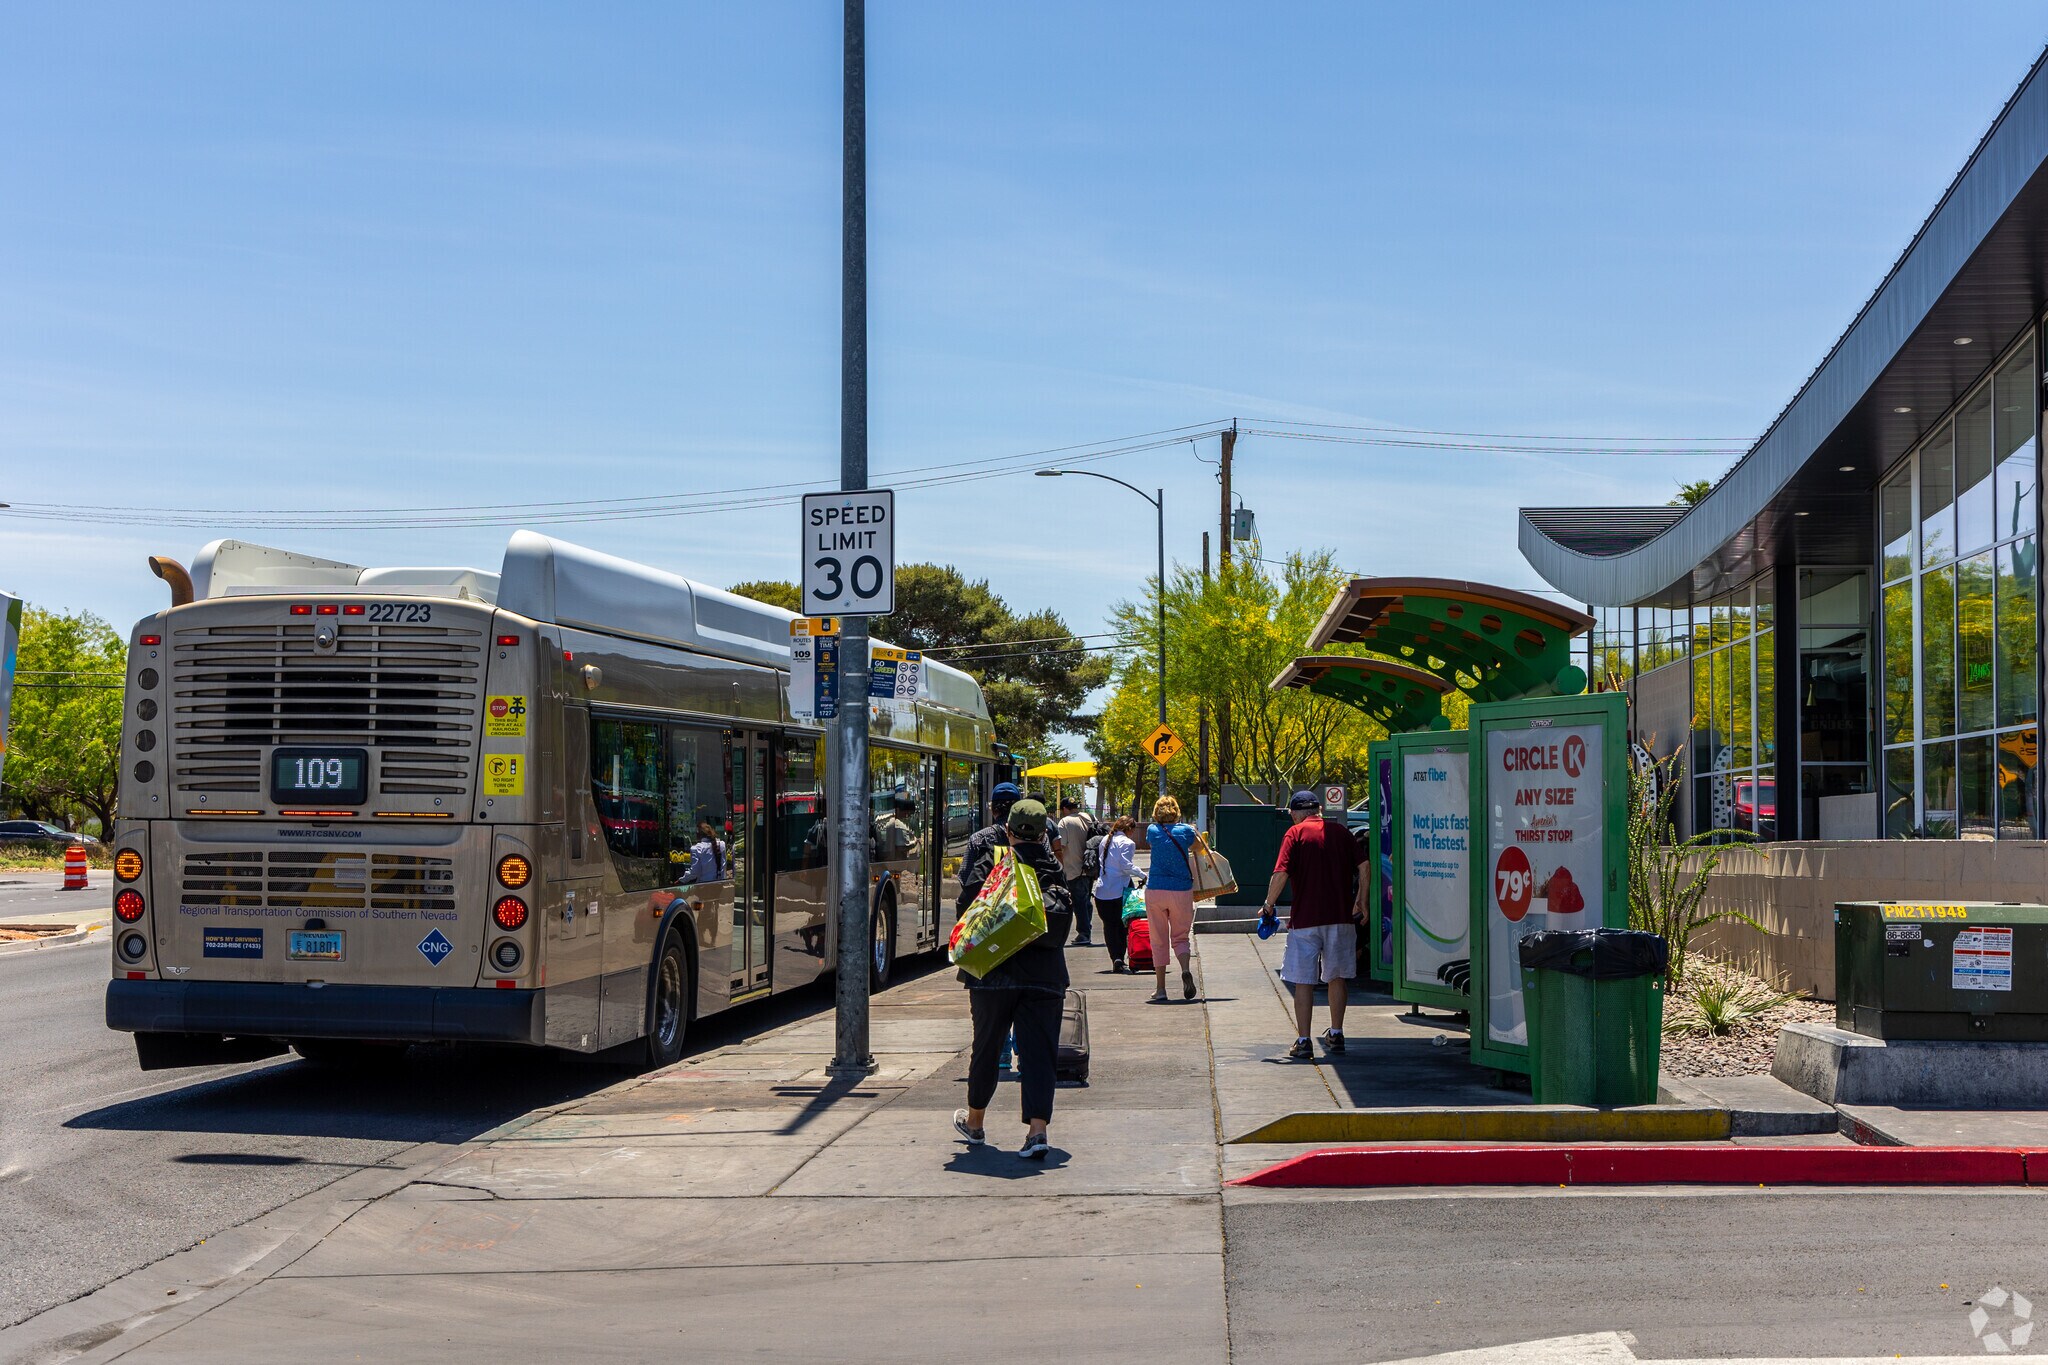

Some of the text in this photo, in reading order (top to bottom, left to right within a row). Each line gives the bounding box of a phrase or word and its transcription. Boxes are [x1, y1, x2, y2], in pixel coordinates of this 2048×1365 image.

[811, 505, 885, 526] SPEED
[818, 530, 877, 551] LIMIT
[812, 555, 884, 601] 30
[369, 604, 432, 622] 22723
[873, 666, 896, 674] GREEN
[1160, 745, 1174, 754] 25
[1503, 741, 1585, 777] CIRCLE K
[294, 758, 344, 789] 109
[1413, 768, 1447, 782] AT&T fiber
[1515, 788, 1542, 806] ANY
[1413, 814, 1429, 830] Not
[1430, 814, 1448, 833] just
[278, 829, 362, 838] WWW.RTCSNV.COM
[1413, 833, 1467, 851] The fastest.
[1515, 829, 1573, 842] THIRST STOP!
[1413, 860, 1459, 870] Internet speeds up to
[1413, 869, 1428, 878] 5-Gigs
[1428, 871, 1444, 880] coming
[1498, 869, 1530, 902] 79¢
[180, 904, 458, 921] Regional Transportation Commission of Southern Nevada
[1885, 905, 1967, 919] PM211948
[306, 941, 339, 953] 81801
[421, 941, 449, 953] CNG
